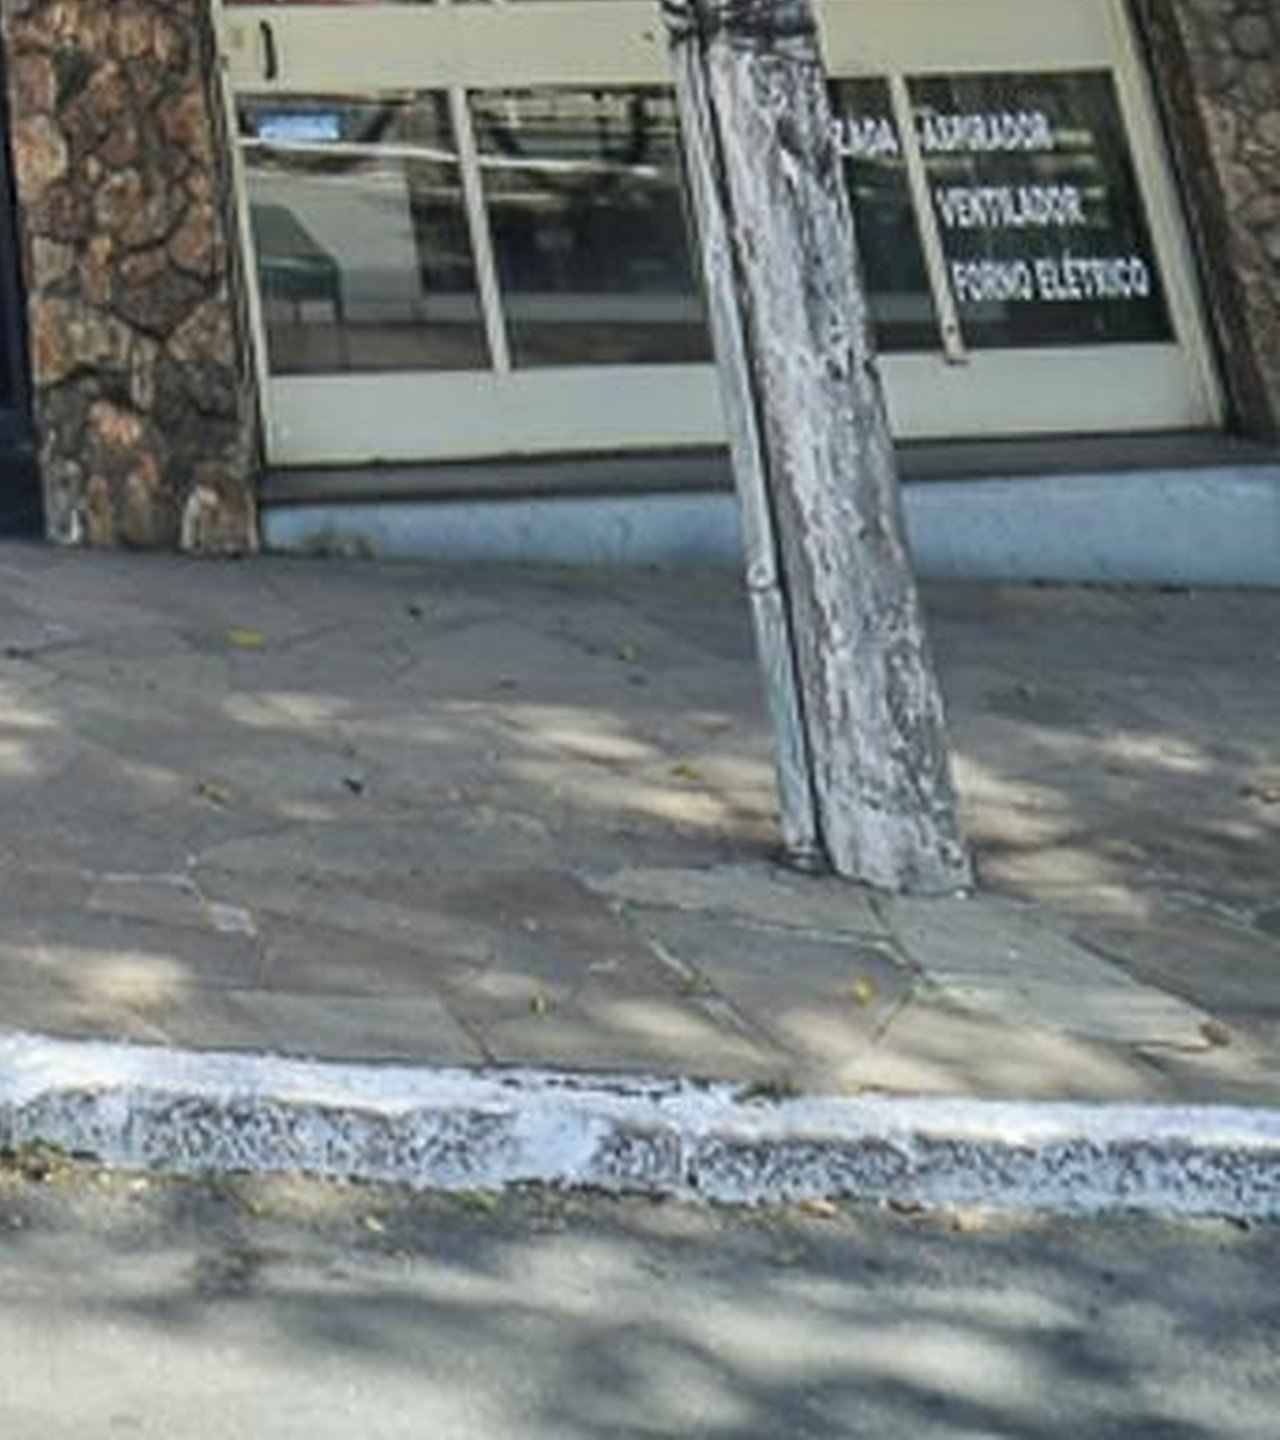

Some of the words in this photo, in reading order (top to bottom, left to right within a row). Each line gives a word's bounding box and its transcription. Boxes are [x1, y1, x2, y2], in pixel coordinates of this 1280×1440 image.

[936, 186, 1088, 229] VENTILADOR
[951, 260, 1033, 302] FORNO
[1036, 247, 1150, 301] ELÉTRICO
